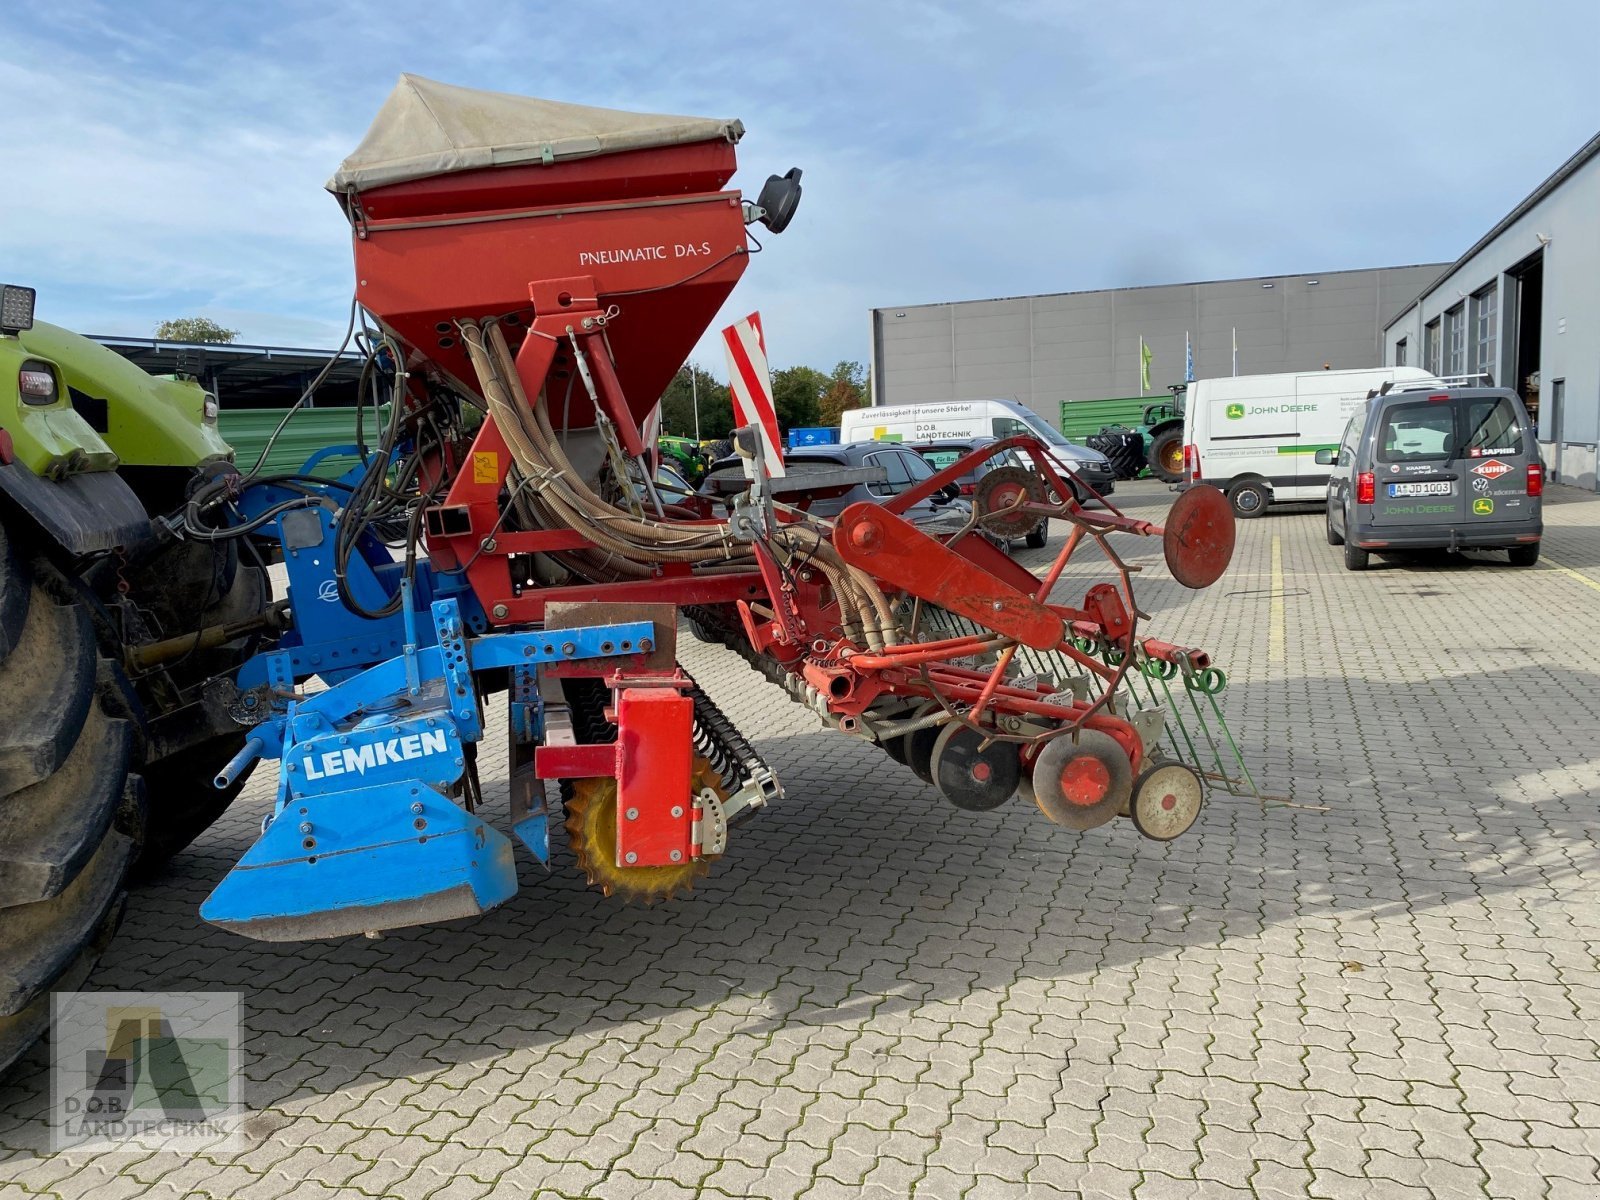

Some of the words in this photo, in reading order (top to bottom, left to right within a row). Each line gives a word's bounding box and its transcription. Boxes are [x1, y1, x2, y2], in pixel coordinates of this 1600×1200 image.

[579, 245, 667, 266] PNEUMATIC
[674, 241, 712, 258] DA-S
[861, 409, 912, 419] Zuverlässigkeit
[946, 404, 972, 413] Stärke!
[1248, 406, 1279, 415] JOHN
[1280, 404, 1318, 413] DEERE
[916, 431, 971, 440] LANDTECHNIK
[1482, 447, 1516, 456] SAPHIR
[1478, 465, 1508, 474] KUHN
[1397, 485, 1402, 493] A
[1409, 484, 1422, 493] JD
[1424, 483, 1449, 492] 1003
[1383, 506, 1414, 515] JOHN
[1416, 504, 1456, 514] DEERE
[303, 729, 448, 781] LEMKEN
